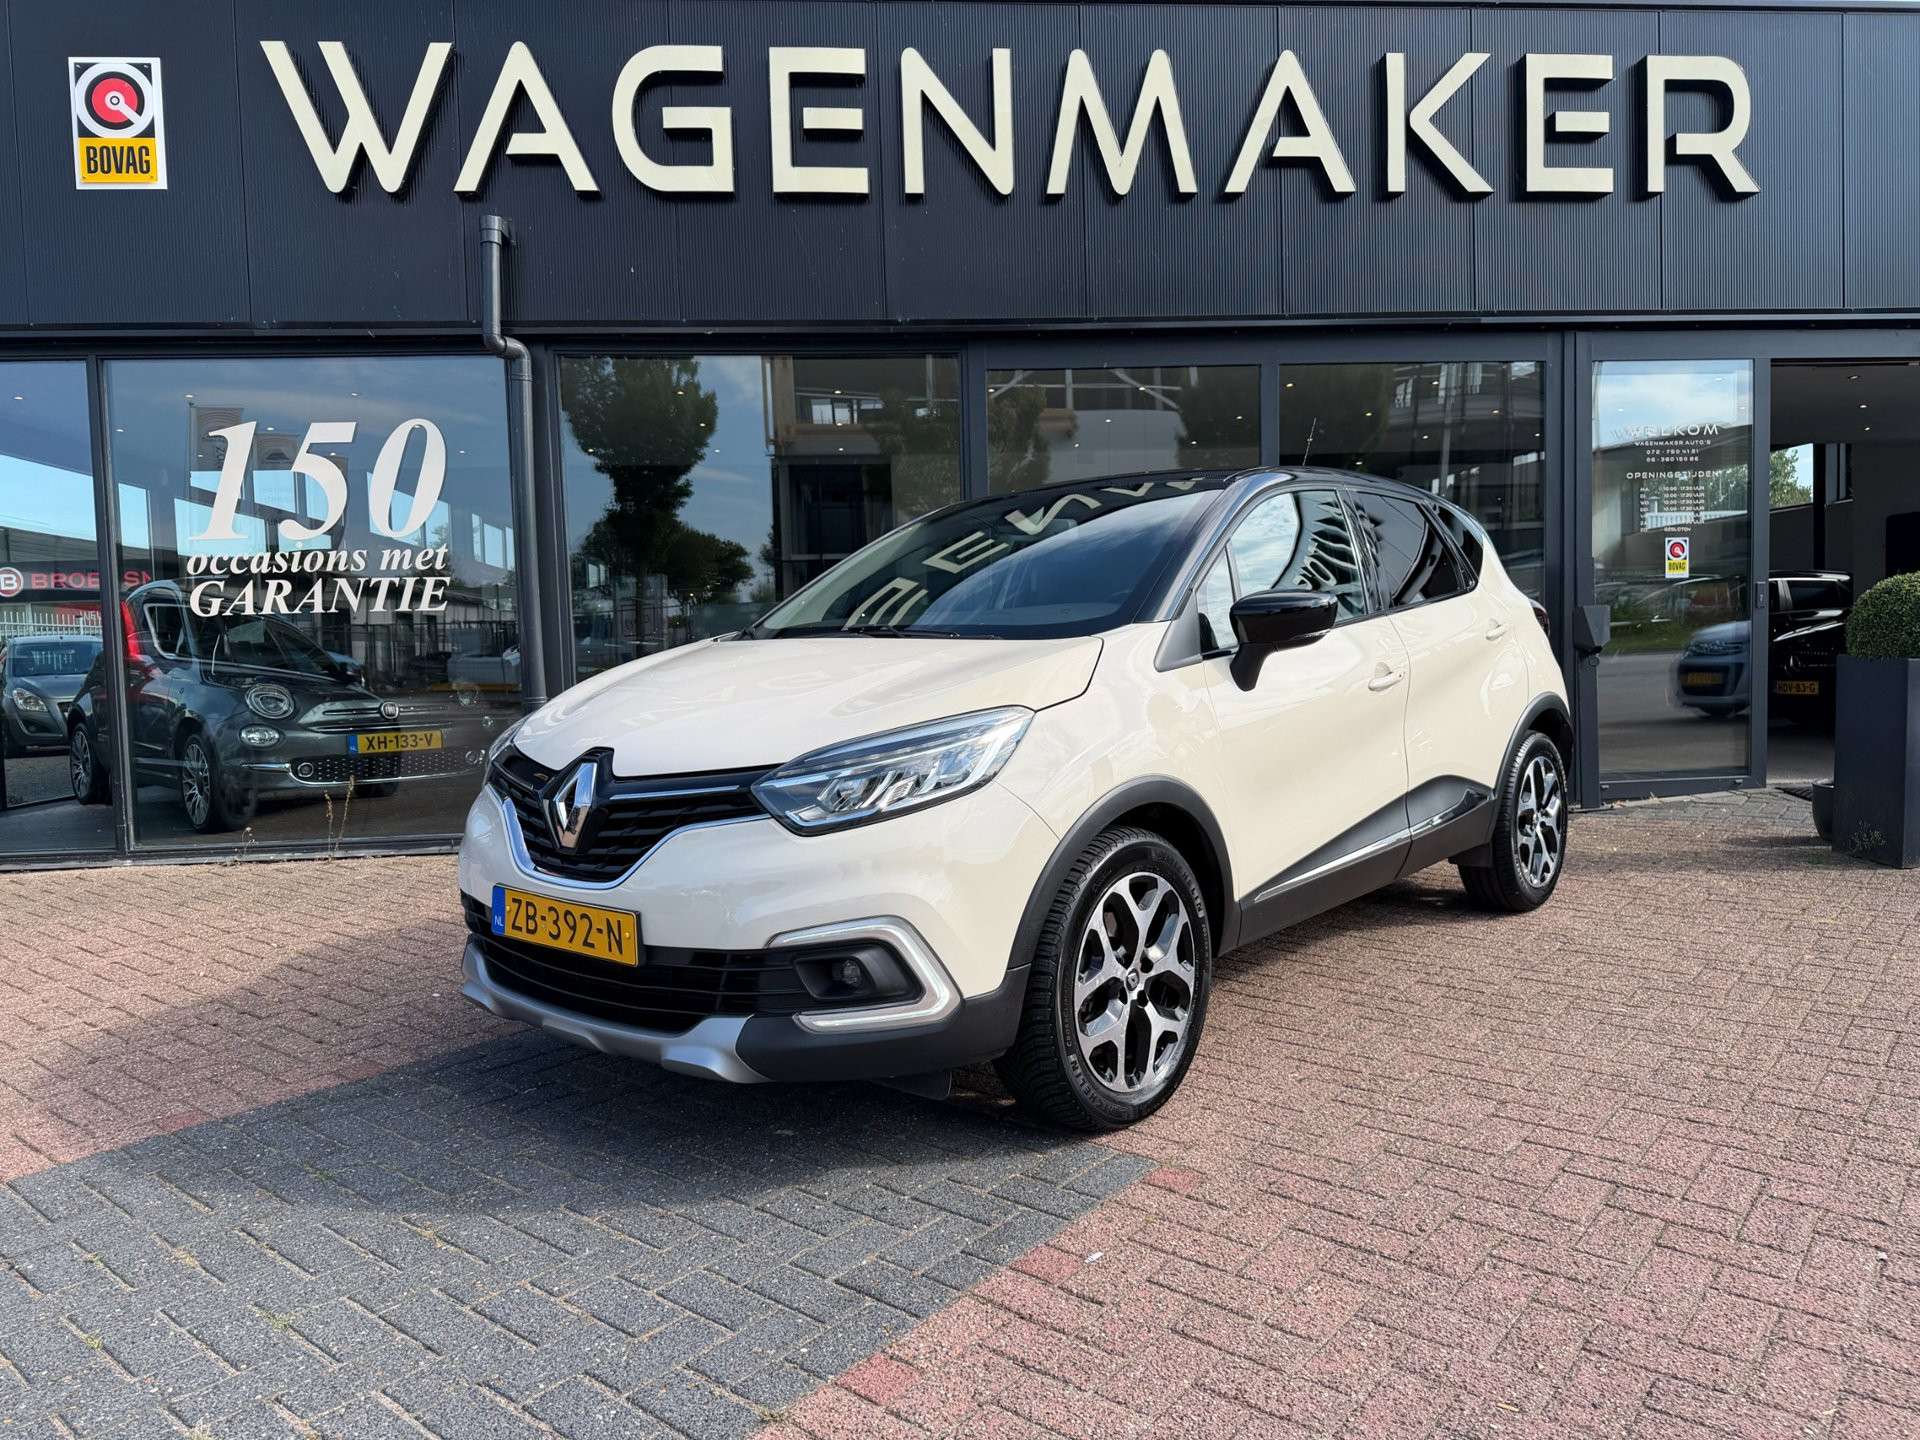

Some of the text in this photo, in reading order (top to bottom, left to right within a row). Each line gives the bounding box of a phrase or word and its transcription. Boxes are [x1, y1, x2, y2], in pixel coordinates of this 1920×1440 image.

[260, 40, 1760, 196] WAGENMAKER
[85, 145, 151, 174] BOVAG
[1631, 423, 1719, 436] WELKOM
[188, 418, 447, 540] 150
[186, 541, 449, 575] occasions met
[1668, 561, 1687, 571] BOVAG
[189, 576, 451, 618] GARANTIE
[366, 733, 433, 751] XH-133-V
[511, 897, 624, 955] ZB-392-N
